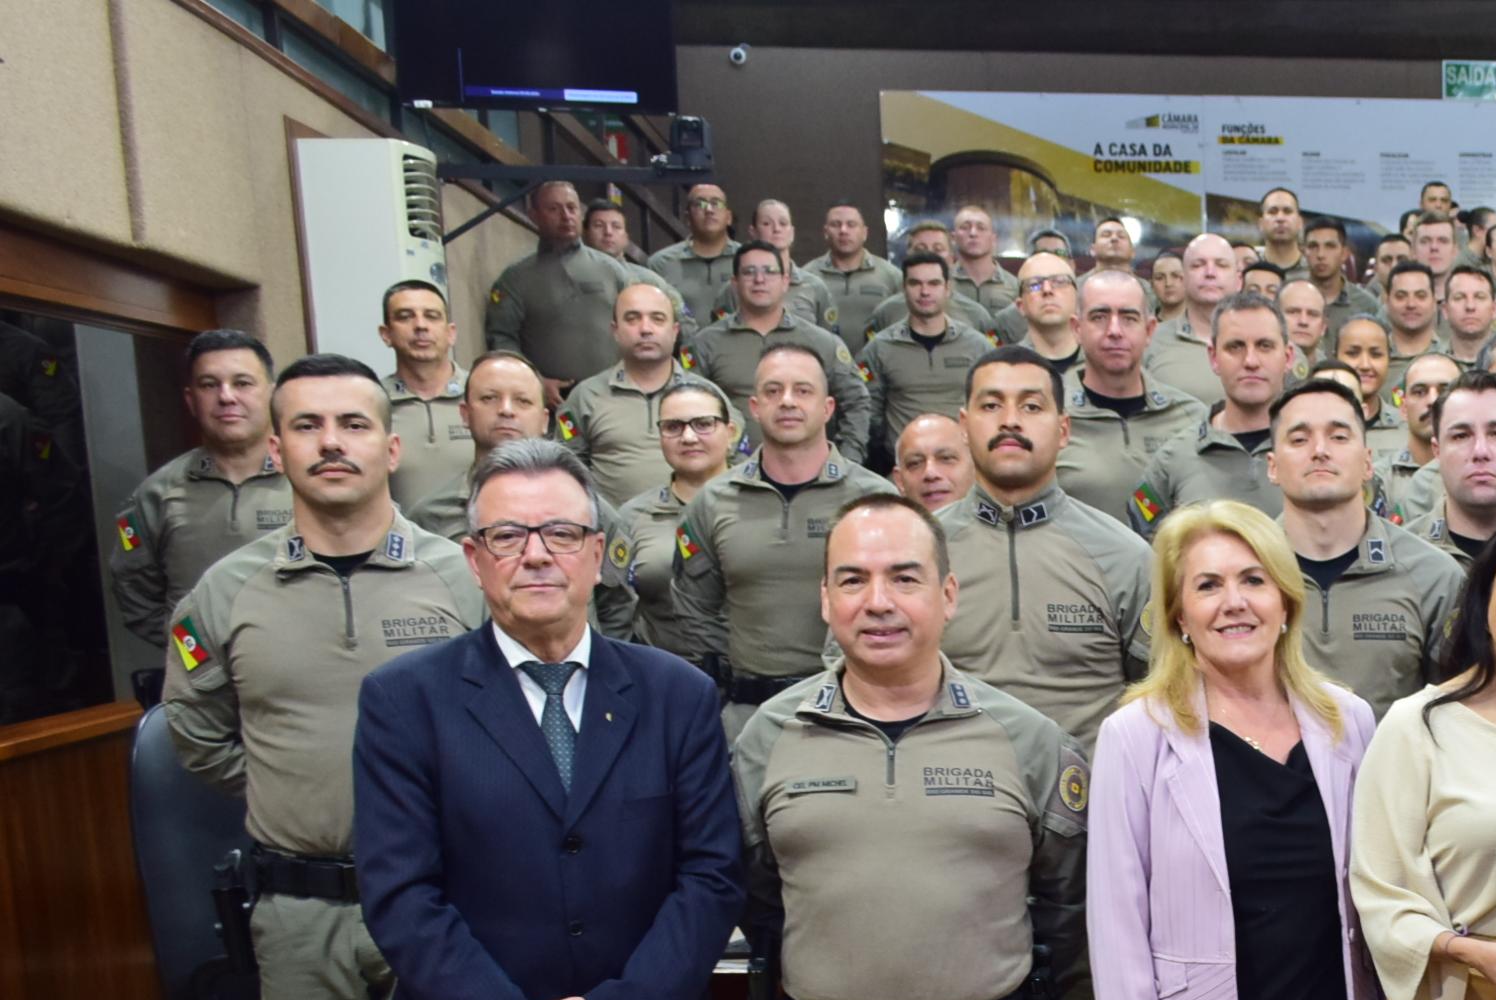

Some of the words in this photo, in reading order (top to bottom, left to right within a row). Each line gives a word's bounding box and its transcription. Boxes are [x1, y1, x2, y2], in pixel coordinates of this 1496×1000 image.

[1161, 112, 1199, 122] CÂMARA
[1222, 123, 1266, 135] FUNÇÕES
[1094, 142, 1104, 156] A
[1108, 142, 1148, 157] CASA
[1153, 143, 1173, 157] DA
[1093, 160, 1192, 173] COMUNIDADE
[382, 616, 447, 628] BRIGADA
[1047, 613, 1104, 623] MILITAR
[1353, 613, 1406, 622] BRIGADA
[384, 626, 449, 637] MILITAR
[1353, 622, 1407, 631] MILITAR
[923, 767, 993, 779] BRIGADA
[923, 776, 994, 788] MILITAR
